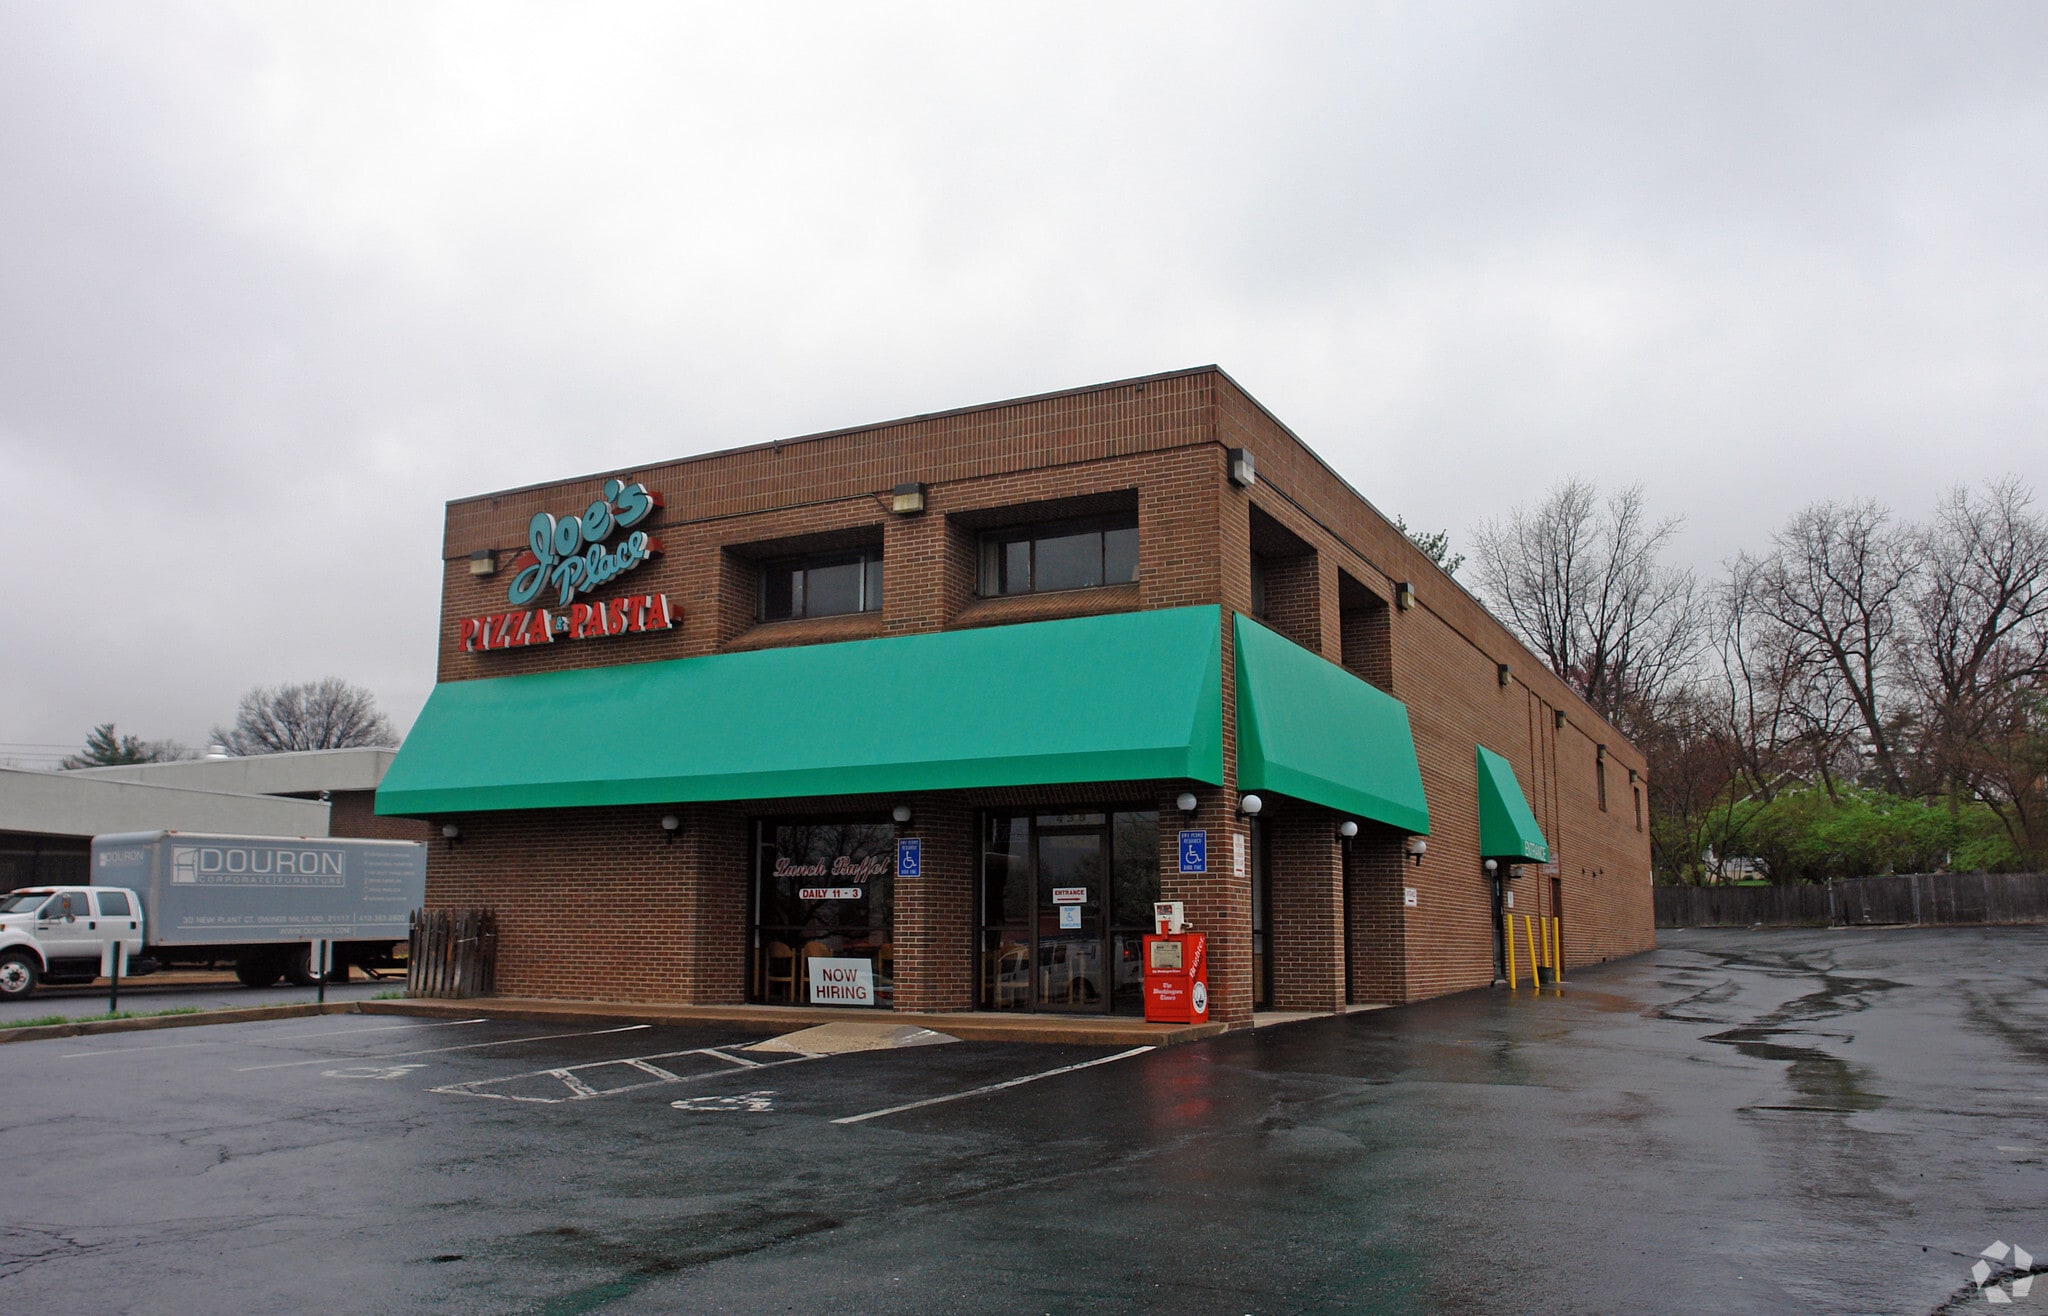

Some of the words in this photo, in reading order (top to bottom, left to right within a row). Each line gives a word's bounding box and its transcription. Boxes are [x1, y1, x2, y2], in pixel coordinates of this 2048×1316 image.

[507, 479, 654, 605] Joe's
[551, 530, 651, 607] Place
[458, 608, 555, 652] PIZZA
[569, 593, 673, 640] PASTA
[1524, 840, 1547, 861] ENTRANCE
[200, 849, 343, 874] DOURON
[773, 857, 825, 877] Lunch
[831, 856, 890, 883] Buffet
[200, 875, 274, 884] CORPORATE
[277, 876, 343, 885] FURNITURE
[802, 889, 828, 898] DAILY
[832, 889, 841, 898] 11
[852, 889, 859, 898] 3
[196, 916, 215, 924] NEW
[217, 916, 240, 924] PLANT
[822, 969, 857, 982] NOW
[816, 986, 867, 999] HIRING
